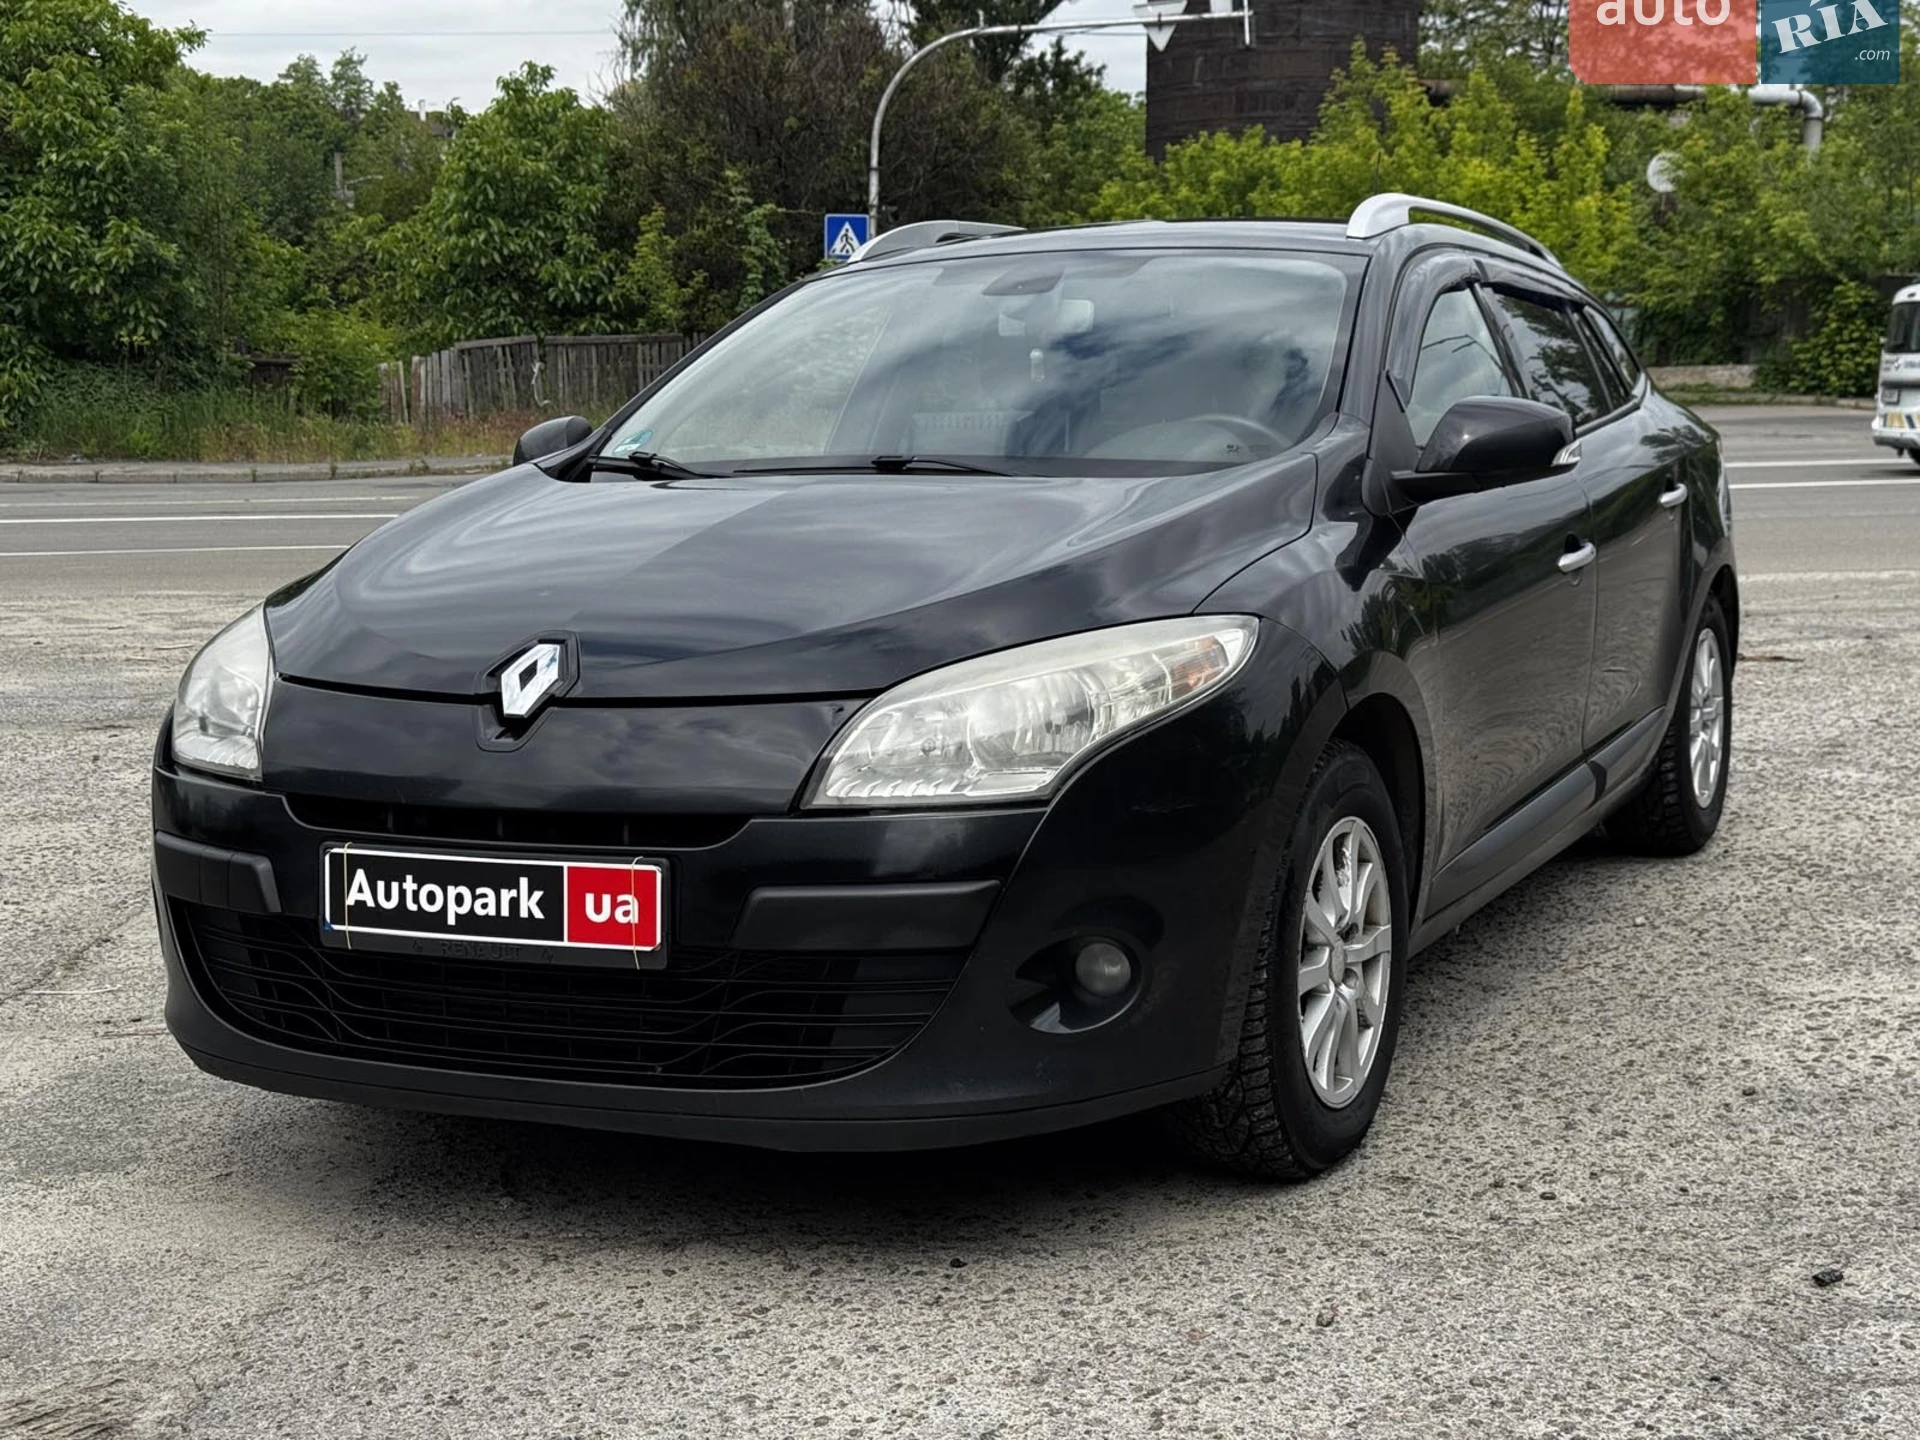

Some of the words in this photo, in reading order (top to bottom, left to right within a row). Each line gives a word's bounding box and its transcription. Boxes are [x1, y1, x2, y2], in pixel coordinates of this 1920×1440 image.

[346, 868, 545, 926] Autopark
[584, 892, 640, 924] ua
[440, 941, 522, 961] RENAULT
